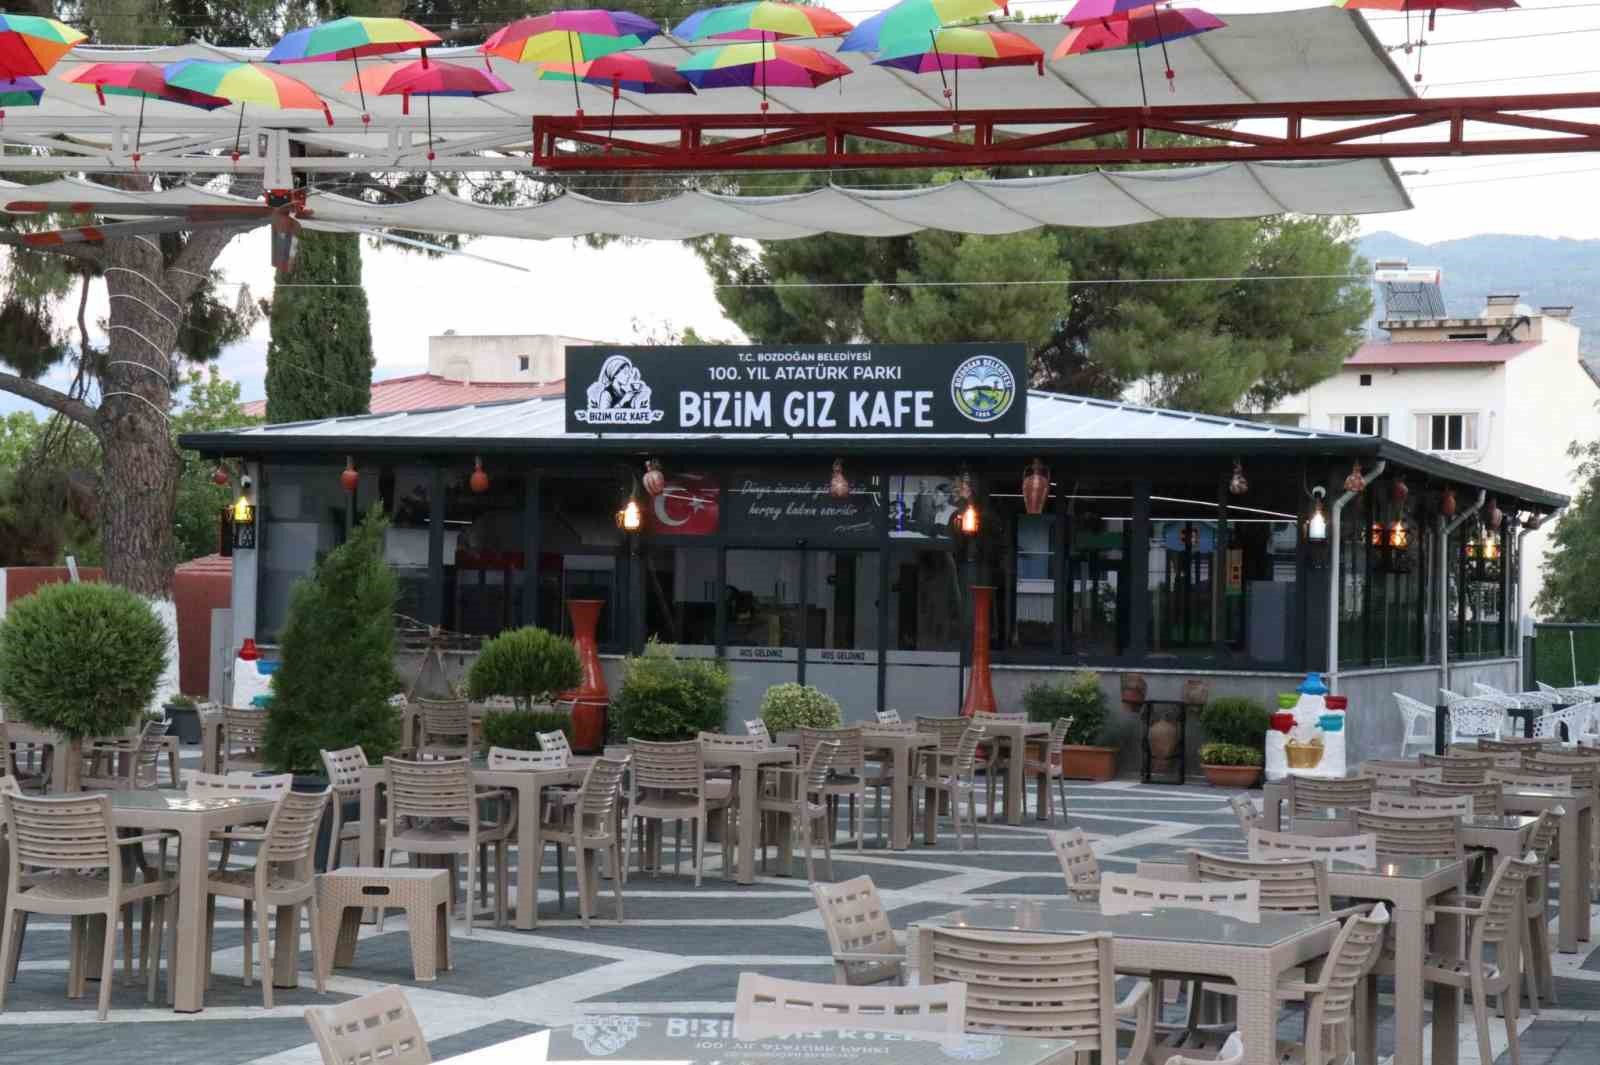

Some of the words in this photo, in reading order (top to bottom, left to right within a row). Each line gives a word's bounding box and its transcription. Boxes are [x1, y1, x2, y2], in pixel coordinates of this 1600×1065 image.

[738, 353, 755, 361] T.C.
[757, 351, 815, 361] BOZDOĞAN
[817, 350, 872, 361] BELEDİYESİ
[708, 366, 742, 380] 100.
[746, 366, 771, 380] YIL
[774, 363, 849, 380] ATATÜRK
[853, 366, 902, 380] PARKI
[783, 390, 837, 428] GIZ
[848, 390, 934, 428] KAFE
[614, 412, 627, 421] GIZ
[630, 412, 649, 421] KAFE
